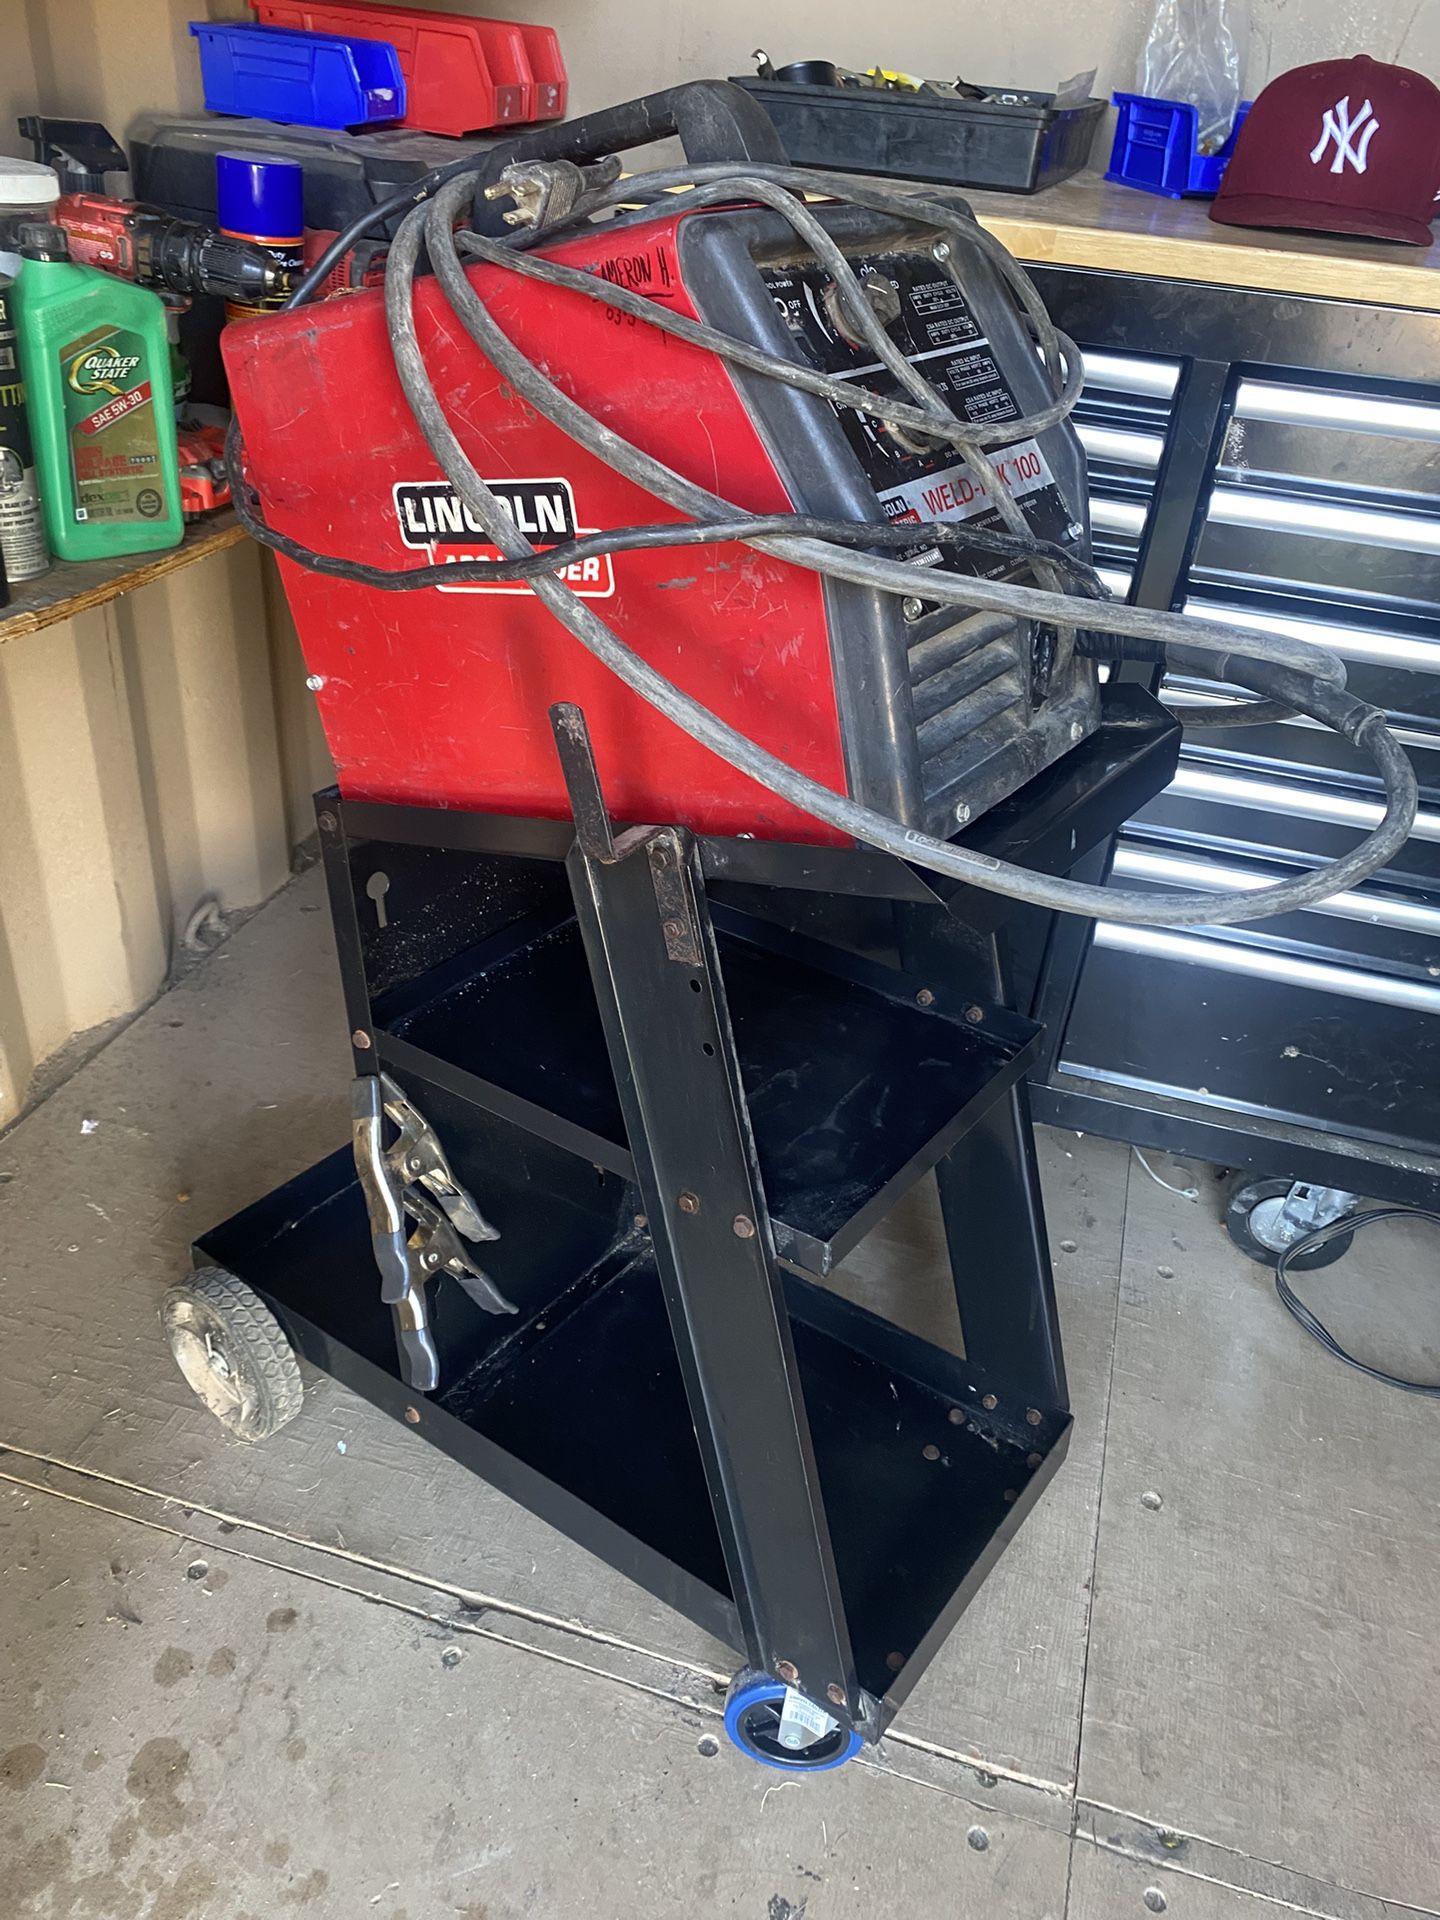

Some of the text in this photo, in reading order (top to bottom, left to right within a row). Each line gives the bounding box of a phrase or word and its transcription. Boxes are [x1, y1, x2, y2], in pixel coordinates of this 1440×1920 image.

[1309, 95, 1380, 175] NY
[788, 299, 801, 310] OFF
[84, 356, 140, 371] QUAKER
[90, 367, 131, 380] STATE
[91, 391, 143, 428] SAE 5W-30
[1012, 451, 1041, 481] 100
